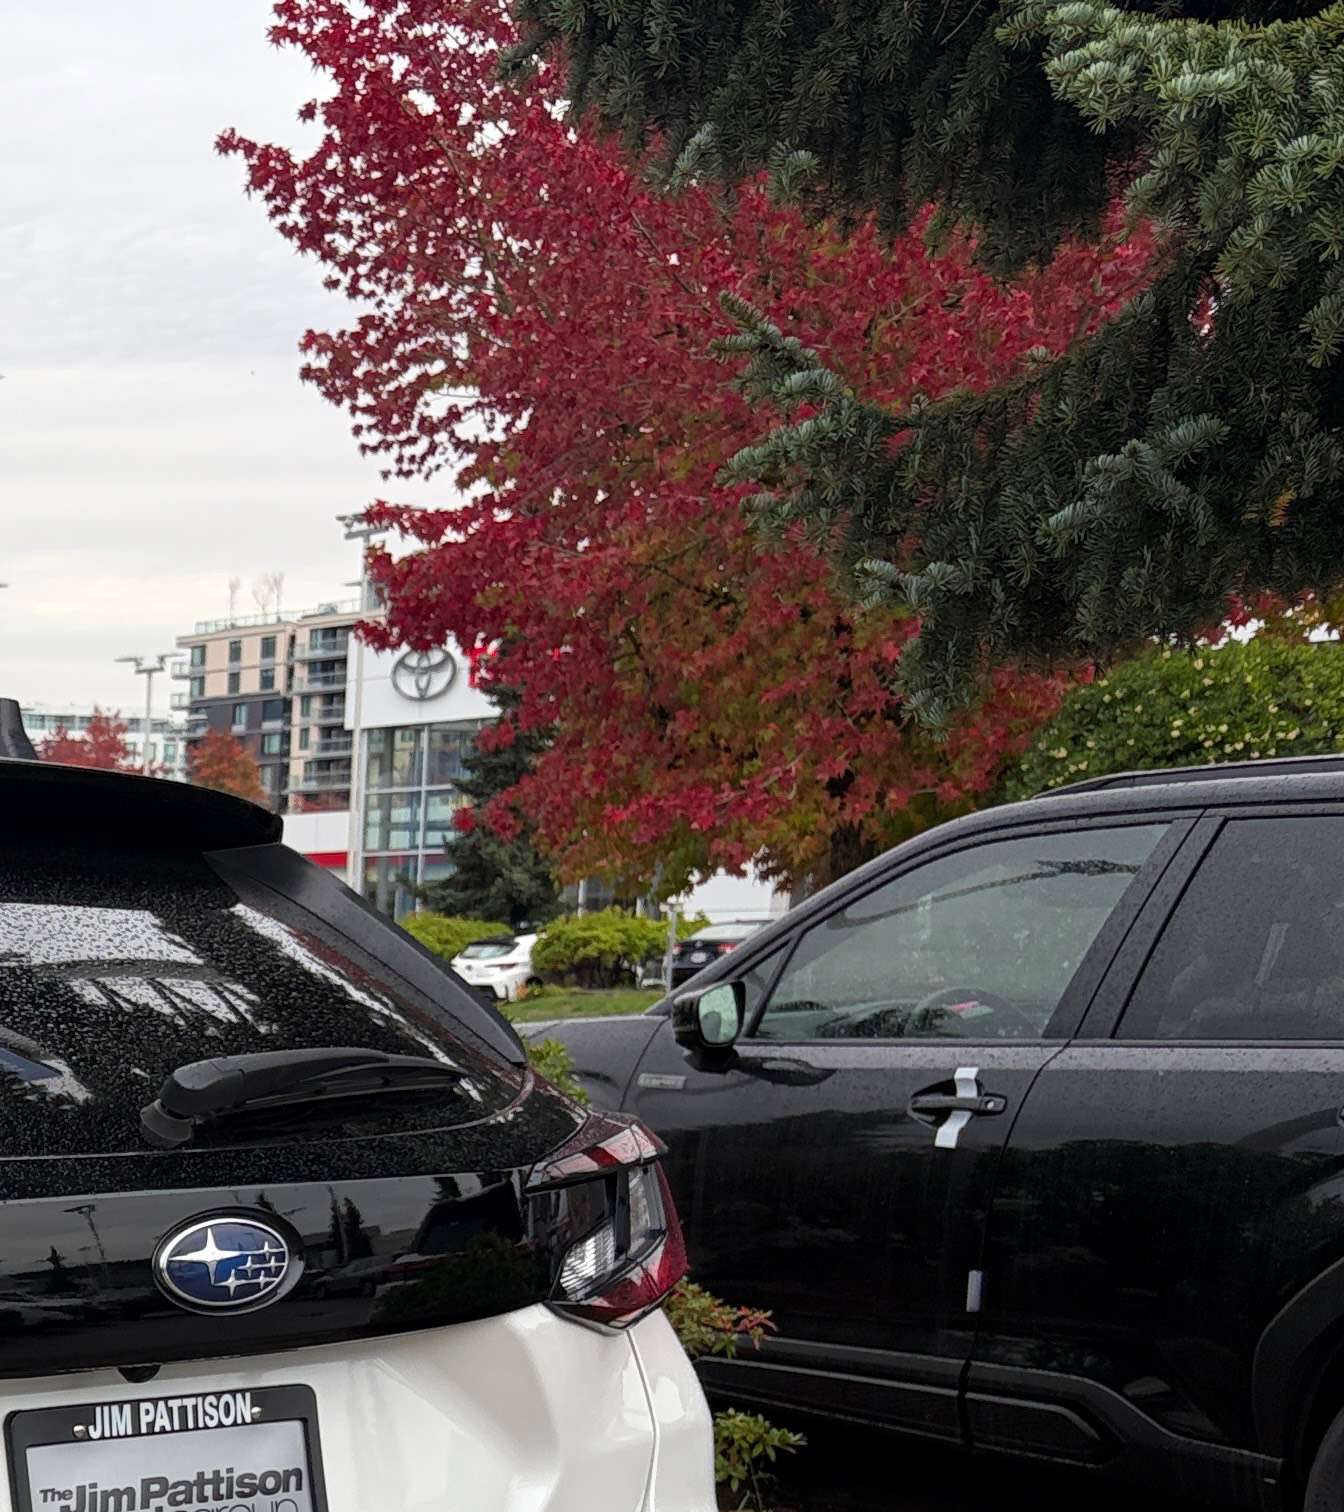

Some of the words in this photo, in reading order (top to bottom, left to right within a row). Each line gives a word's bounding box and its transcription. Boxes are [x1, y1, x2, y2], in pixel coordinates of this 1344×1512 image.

[88, 1405, 132, 1440] JIM
[139, 1391, 251, 1434] PATTISON
[39, 1485, 74, 1504] The
[140, 1467, 304, 1510] Pattison
